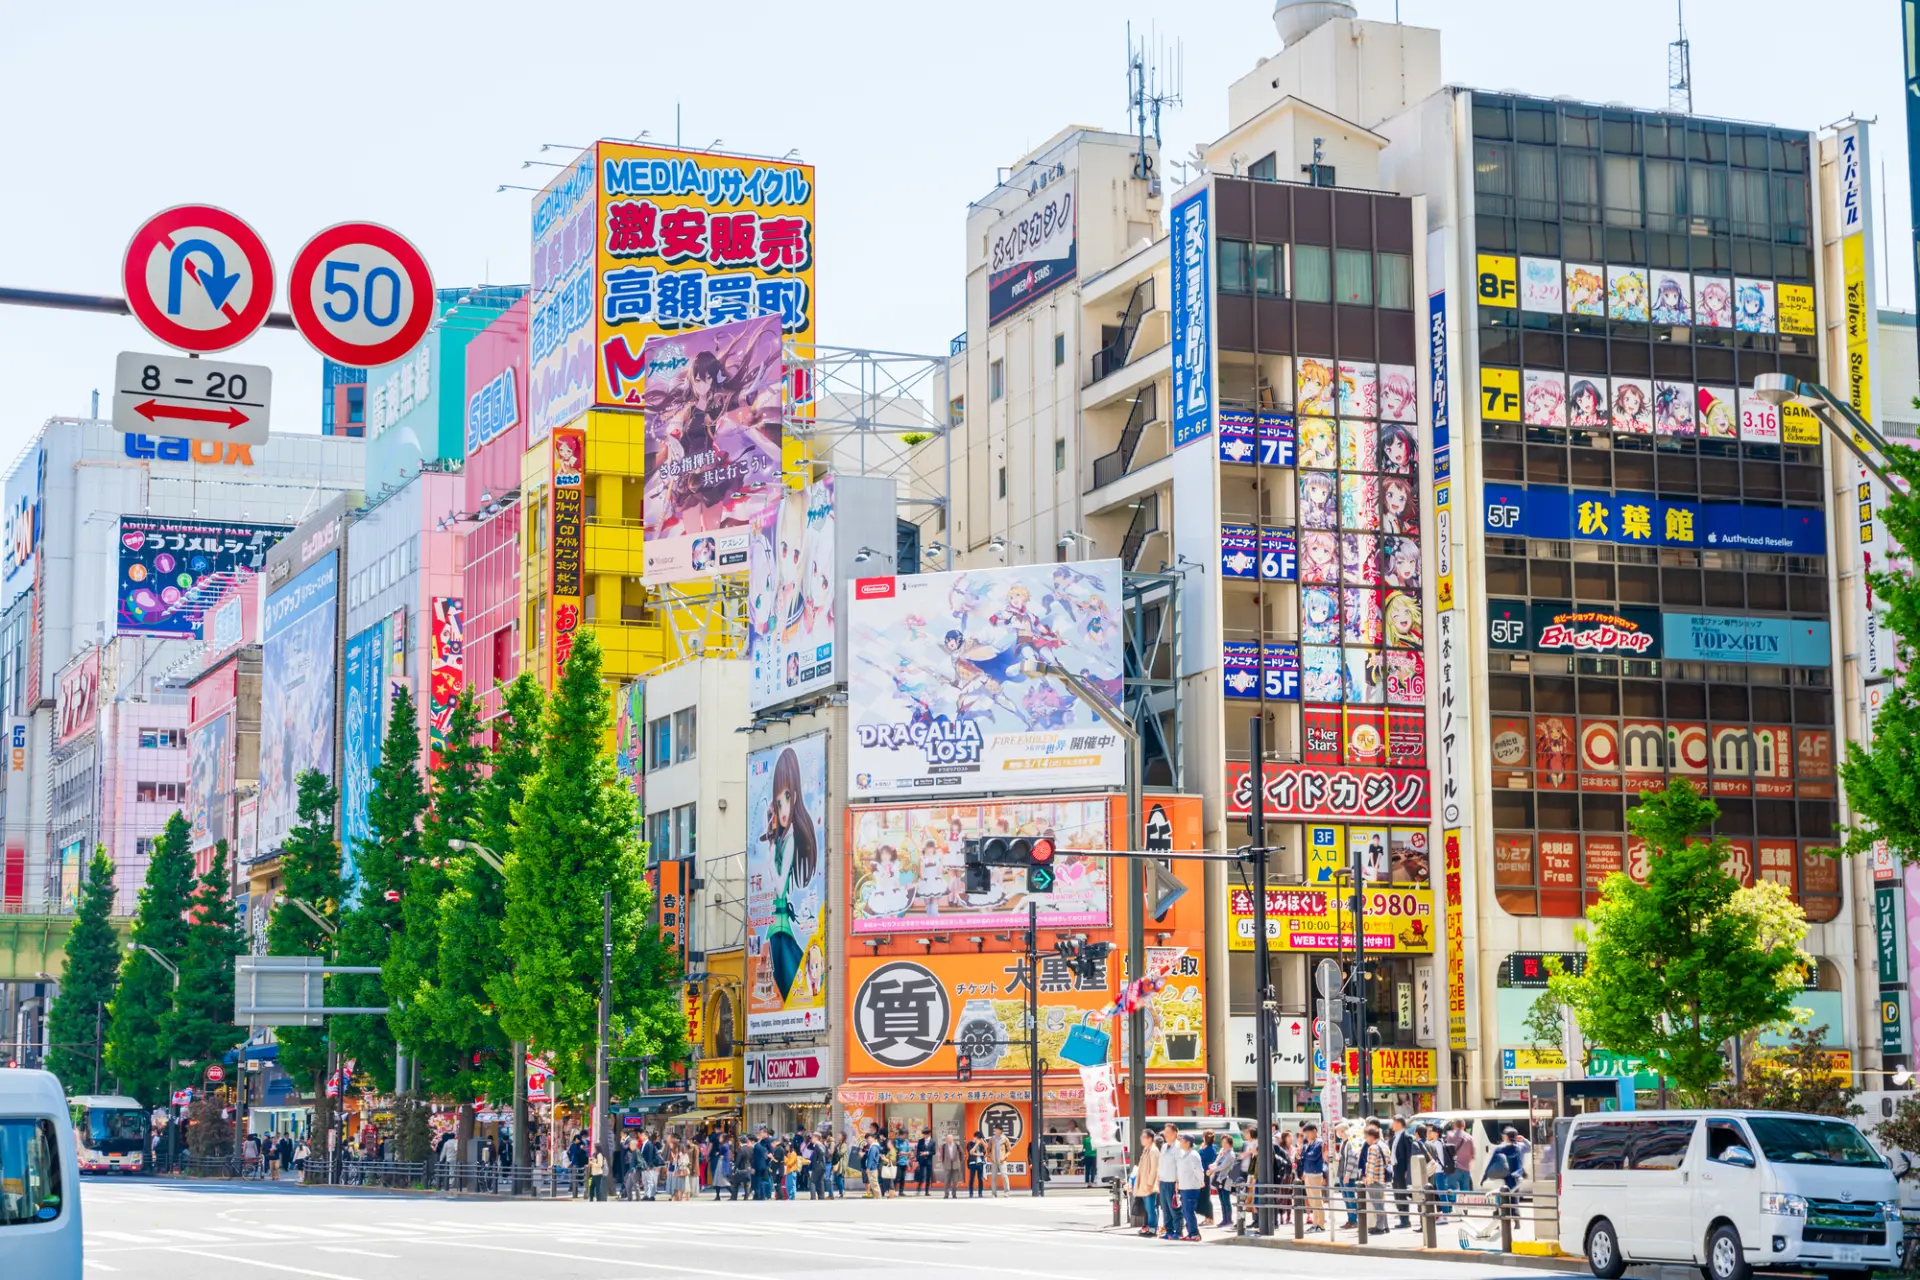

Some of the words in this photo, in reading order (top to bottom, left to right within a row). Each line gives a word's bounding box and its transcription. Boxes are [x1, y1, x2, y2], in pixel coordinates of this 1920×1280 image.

[604, 158, 811, 206] MEDIAリサイクル
[1842, 135, 1858, 225] スーパービル
[606, 199, 809, 270] 激安販売
[993, 192, 1071, 270] メイドカジノ
[323, 260, 401, 327] 50
[1480, 272, 1515, 299] 8F
[603, 267, 806, 327] 高額買取
[1847, 282, 1859, 338] Yellow
[1175, 354, 1184, 420] 秋葉原店
[1850, 352, 1864, 443] Submare
[1482, 386, 1518, 412] 7F
[467, 366, 517, 456] SEGA
[1743, 411, 1776, 430] 3.16
[1261, 440, 1293, 464] 7F
[556, 474, 580, 486] あなたの
[556, 489, 579, 501] DVD
[1438, 491, 1448, 504] 3F
[555, 502, 579, 513] ブルーレイ
[1488, 504, 1519, 529] 5F
[122, 522, 156, 531] ADULT
[158, 523, 222, 535] AMUSEMENT
[555, 513, 579, 525] ゲーム
[1577, 500, 1695, 542] 秋葉館
[559, 525, 575, 537] CD
[1721, 534, 1765, 546] Authorized
[1765, 537, 1794, 548] Reseller
[146, 533, 258, 553] ラブメルシー
[555, 537, 579, 548] アイドル
[1439, 514, 1449, 574] りらくる
[555, 549, 579, 560] アニメ
[1262, 553, 1295, 577] 6F
[556, 561, 578, 572] コミック
[863, 585, 889, 593] Nintendo
[1554, 612, 1596, 624] ホビーショップ
[1491, 620, 1523, 643] 5F
[1265, 671, 1299, 697] 5F
[1387, 676, 1425, 694] 3.16
[858, 719, 982, 749] DRAGALIA
[990, 735, 1018, 753] FIRE
[1069, 735, 1116, 750] 開催中!
[925, 737, 982, 764] LOST
[1307, 739, 1338, 752] Stars
[1584, 727, 1771, 771] amiami
[1798, 736, 1827, 758] 4F
[1317, 831, 1332, 843] 3F
[1311, 849, 1337, 862] 入口
[1495, 847, 1531, 860] 4/27
[1545, 856, 1570, 868] Tax
[1445, 836, 1461, 907] 免税
[1543, 869, 1573, 883] Free
[1235, 894, 1324, 914] 全もみほぐし
[1455, 912, 1463, 952] TAX
[1879, 896, 1893, 976] リバティー
[955, 982, 999, 996] チケット
[1004, 957, 1108, 994] 大黒屋
[1457, 958, 1465, 1012] FREE
[866, 975, 938, 1055] 質
[1420, 979, 1430, 1036] ルノアール
[768, 1060, 793, 1078] COMIC
[795, 1060, 806, 1077] ZIN
[1245, 1051, 1306, 1065] ルアール
[1379, 1050, 1400, 1068] TAX
[1402, 1050, 1429, 1069] FREE
[1380, 1069, 1430, 1085] 면세점
